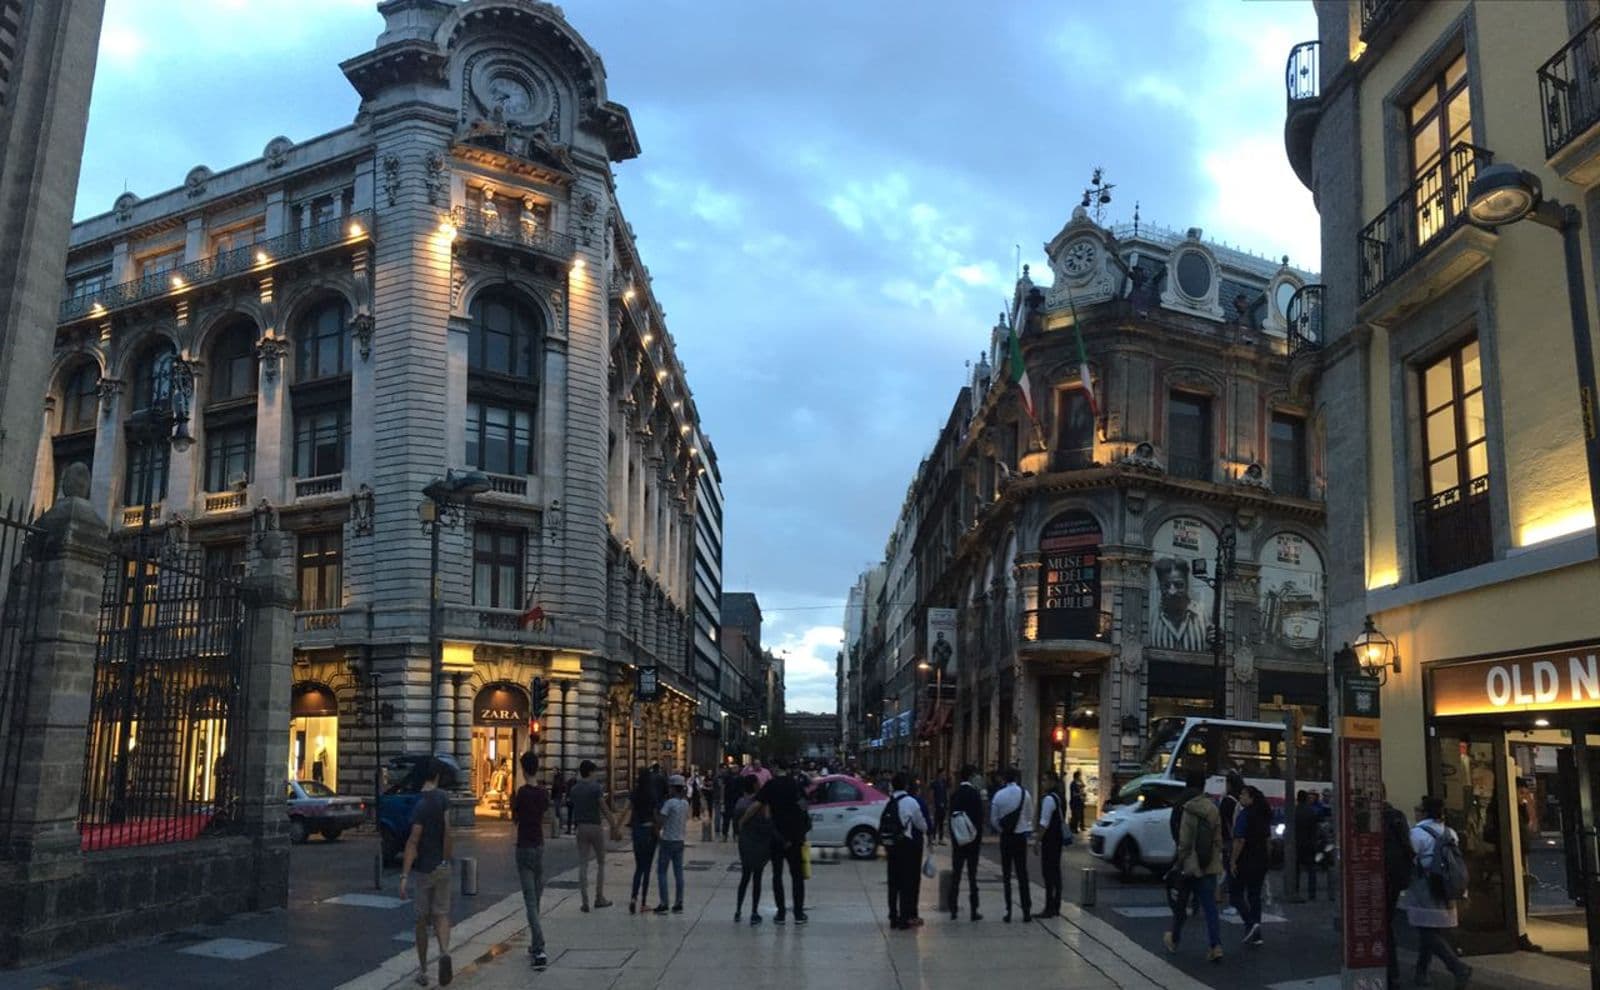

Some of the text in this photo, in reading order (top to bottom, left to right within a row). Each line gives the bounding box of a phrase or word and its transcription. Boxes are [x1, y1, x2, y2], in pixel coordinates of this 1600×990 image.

[1486, 655, 1600, 707] OLD N
[481, 710, 520, 720] ZARA
